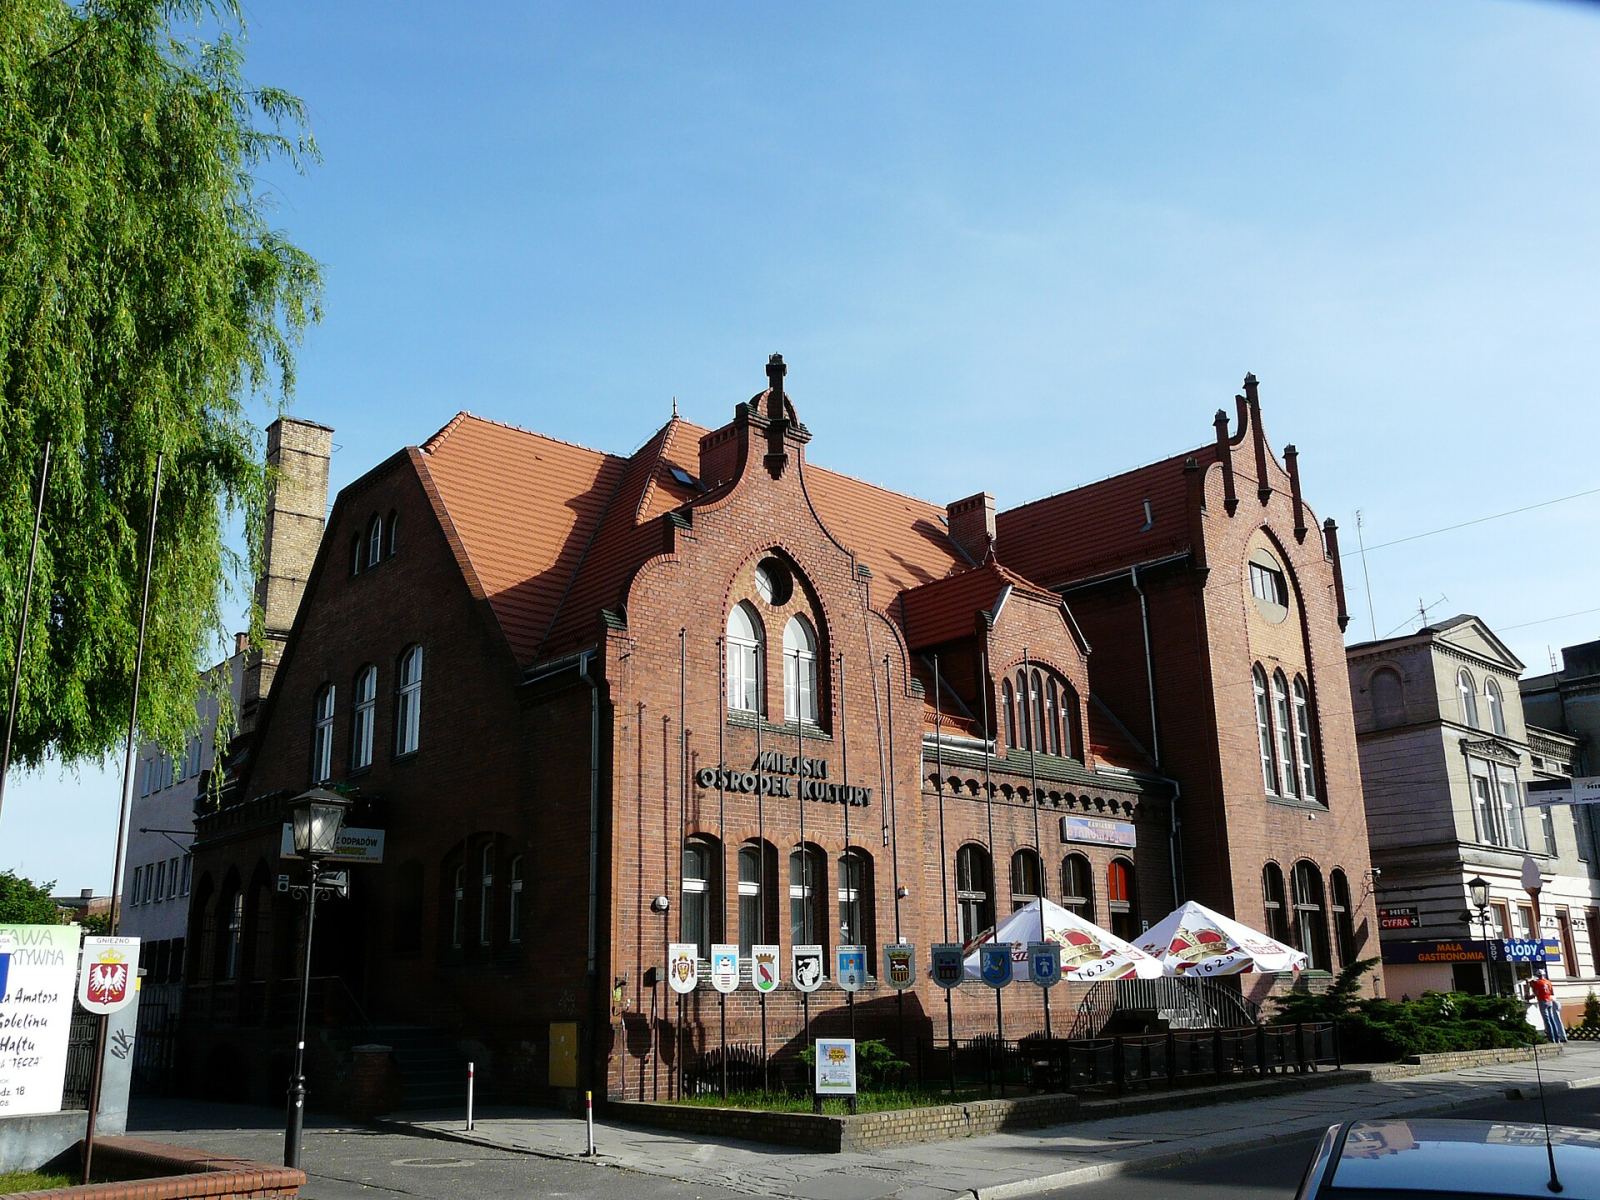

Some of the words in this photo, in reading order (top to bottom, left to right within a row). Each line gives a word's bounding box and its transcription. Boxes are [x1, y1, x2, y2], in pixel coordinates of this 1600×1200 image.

[754, 751, 829, 779] MIEJSKI
[697, 762, 793, 798] OŚRODEK
[797, 779, 873, 807] KULTURY
[341, 836, 378, 848] ODPADÓW
[1418, 951, 1485, 961] GASTRONOMIA
[1510, 944, 1538, 957] LODY
[1077, 959, 1115, 980] 1629
[1195, 954, 1235, 977] 1629
[16, 1085, 26, 1096] 18
